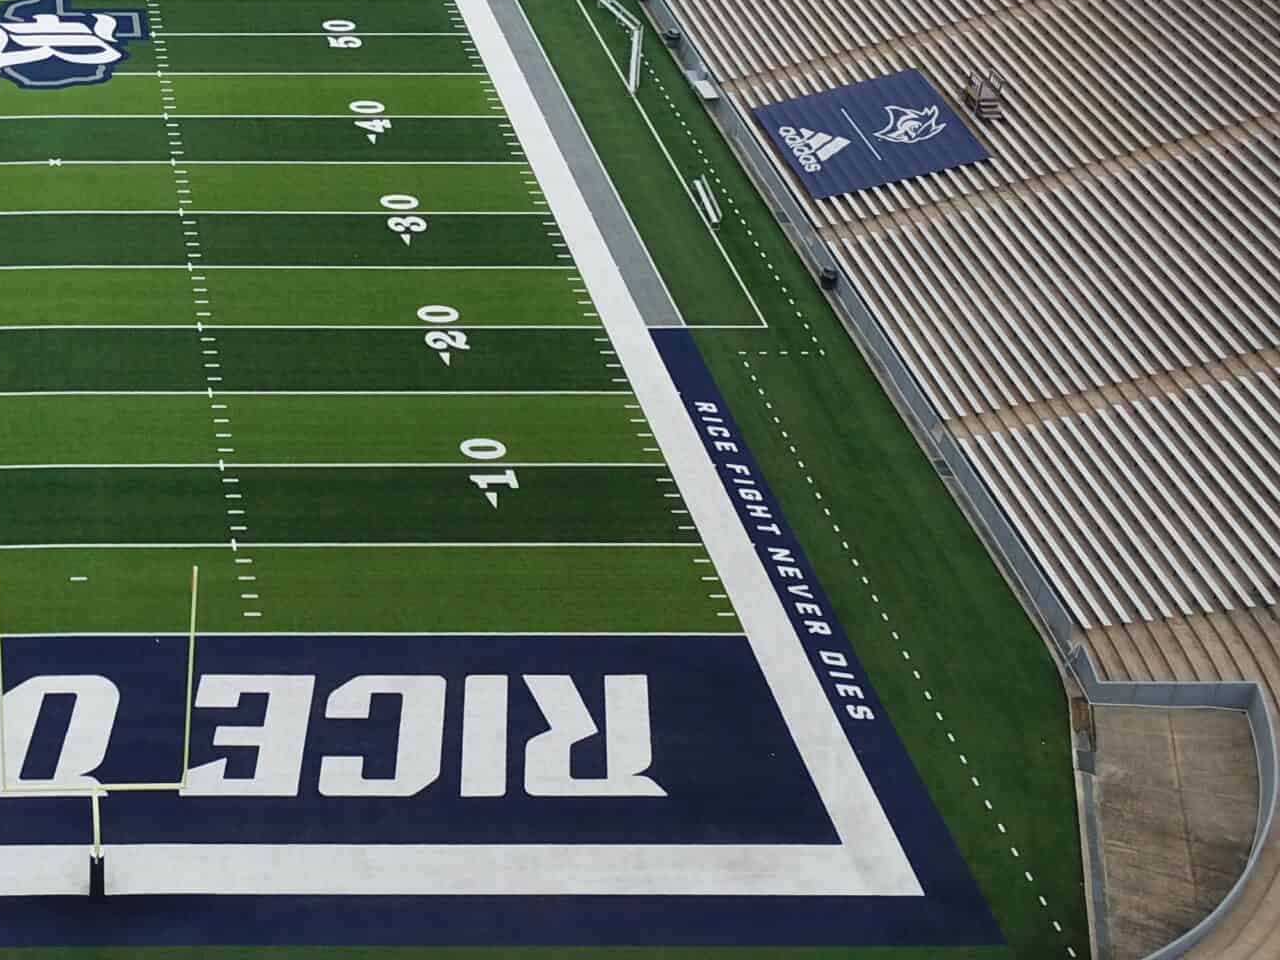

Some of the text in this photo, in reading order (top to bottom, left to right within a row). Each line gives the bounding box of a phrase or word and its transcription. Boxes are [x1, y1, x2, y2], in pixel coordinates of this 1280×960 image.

[323, 20, 362, 48] 50
[350, 101, 393, 133] 40
[778, 125, 822, 173] adidas
[380, 194, 427, 232] 30
[417, 305, 470, 350] 20
[460, 438, 519, 489] 10
[694, 401, 875, 721] RICE FIGHT NEVER DIES
[179, 674, 668, 798] RICE
